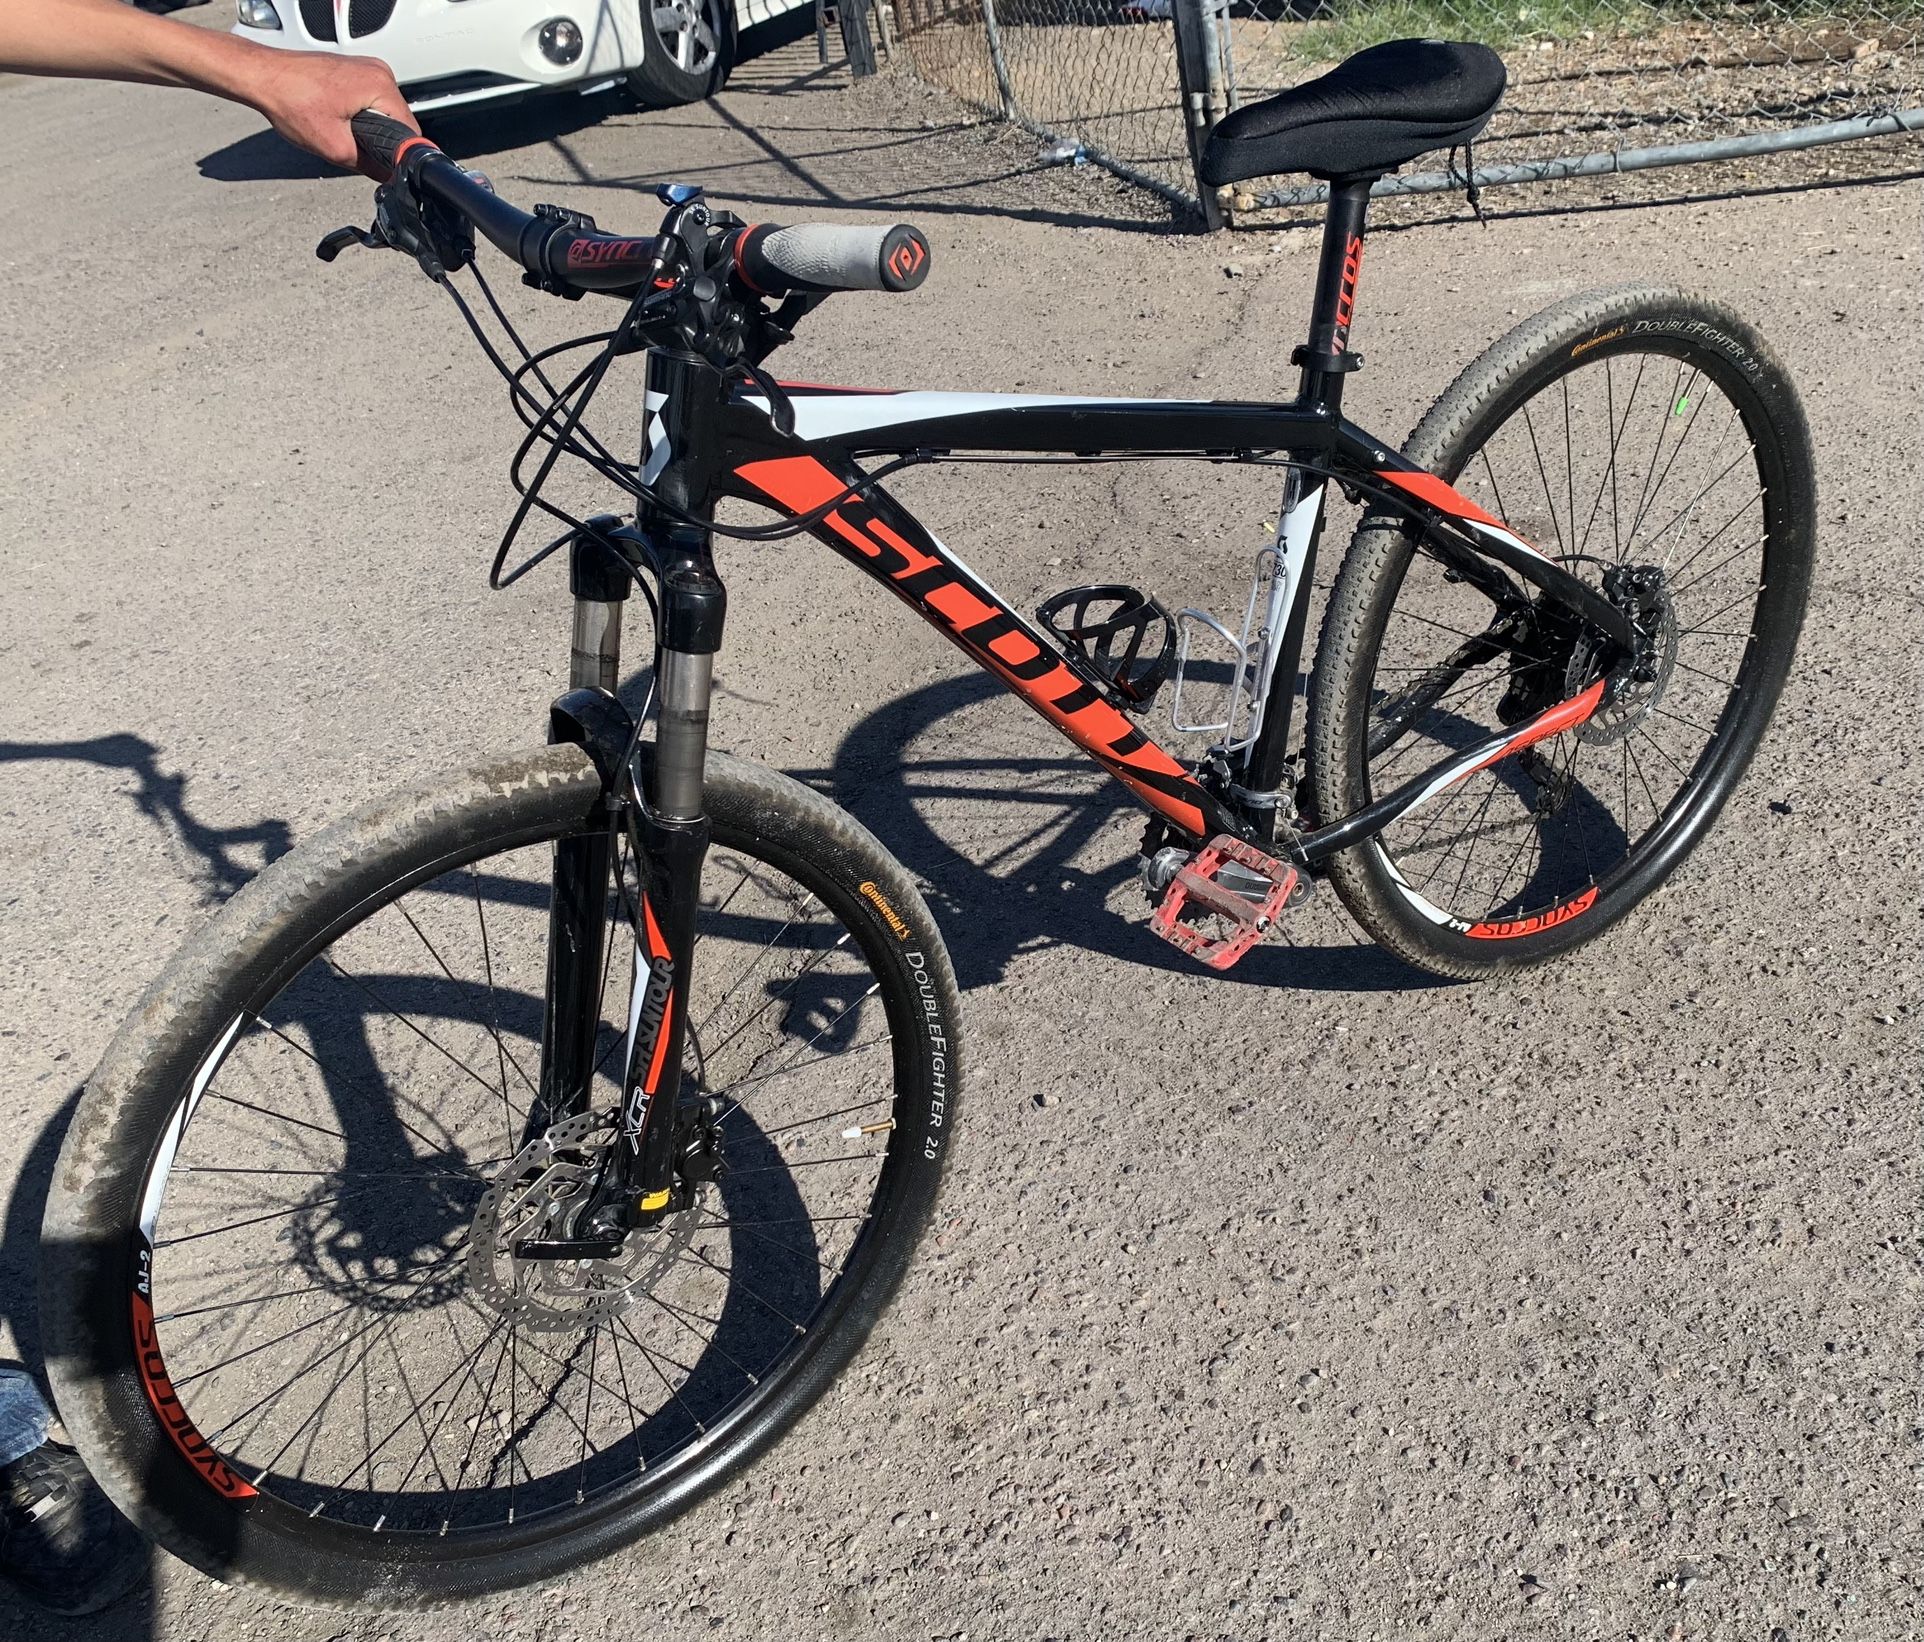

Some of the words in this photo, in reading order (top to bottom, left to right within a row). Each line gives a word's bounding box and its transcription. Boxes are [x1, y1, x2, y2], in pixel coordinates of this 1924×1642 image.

[1571, 328, 1619, 357] Continental
[834, 497, 1149, 758] SCOTT
[859, 881, 907, 934] Continental
[623, 1086, 650, 1157] XCR
[924, 1135, 939, 1159] 2.0
[138, 1249, 151, 1294] AJ-2
[137, 1319, 236, 1492] SYNCROS
